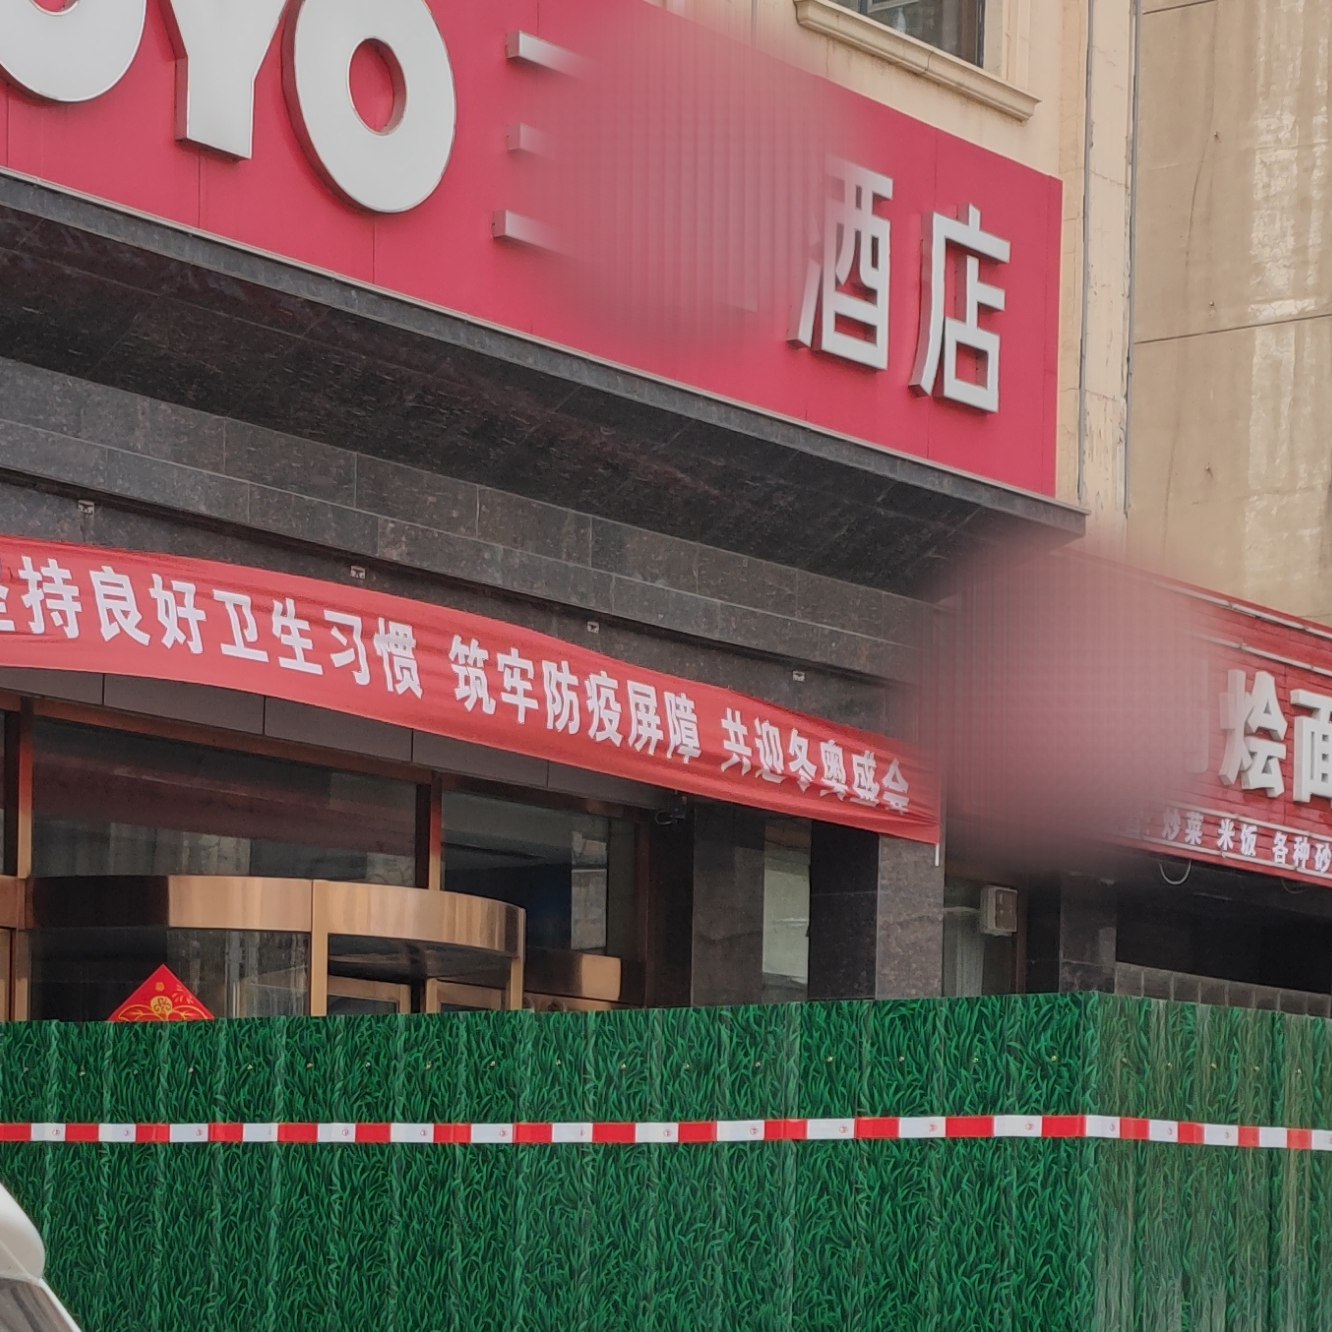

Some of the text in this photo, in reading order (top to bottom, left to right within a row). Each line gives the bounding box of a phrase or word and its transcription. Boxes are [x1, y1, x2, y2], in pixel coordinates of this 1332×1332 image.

[786, 155, 1011, 413] 酒店
[448, 634, 702, 764] 筑牢防疫屏障
[720, 706, 911, 815] 共迎冬奥盛会
[1217, 818, 1258, 857] 米饭
